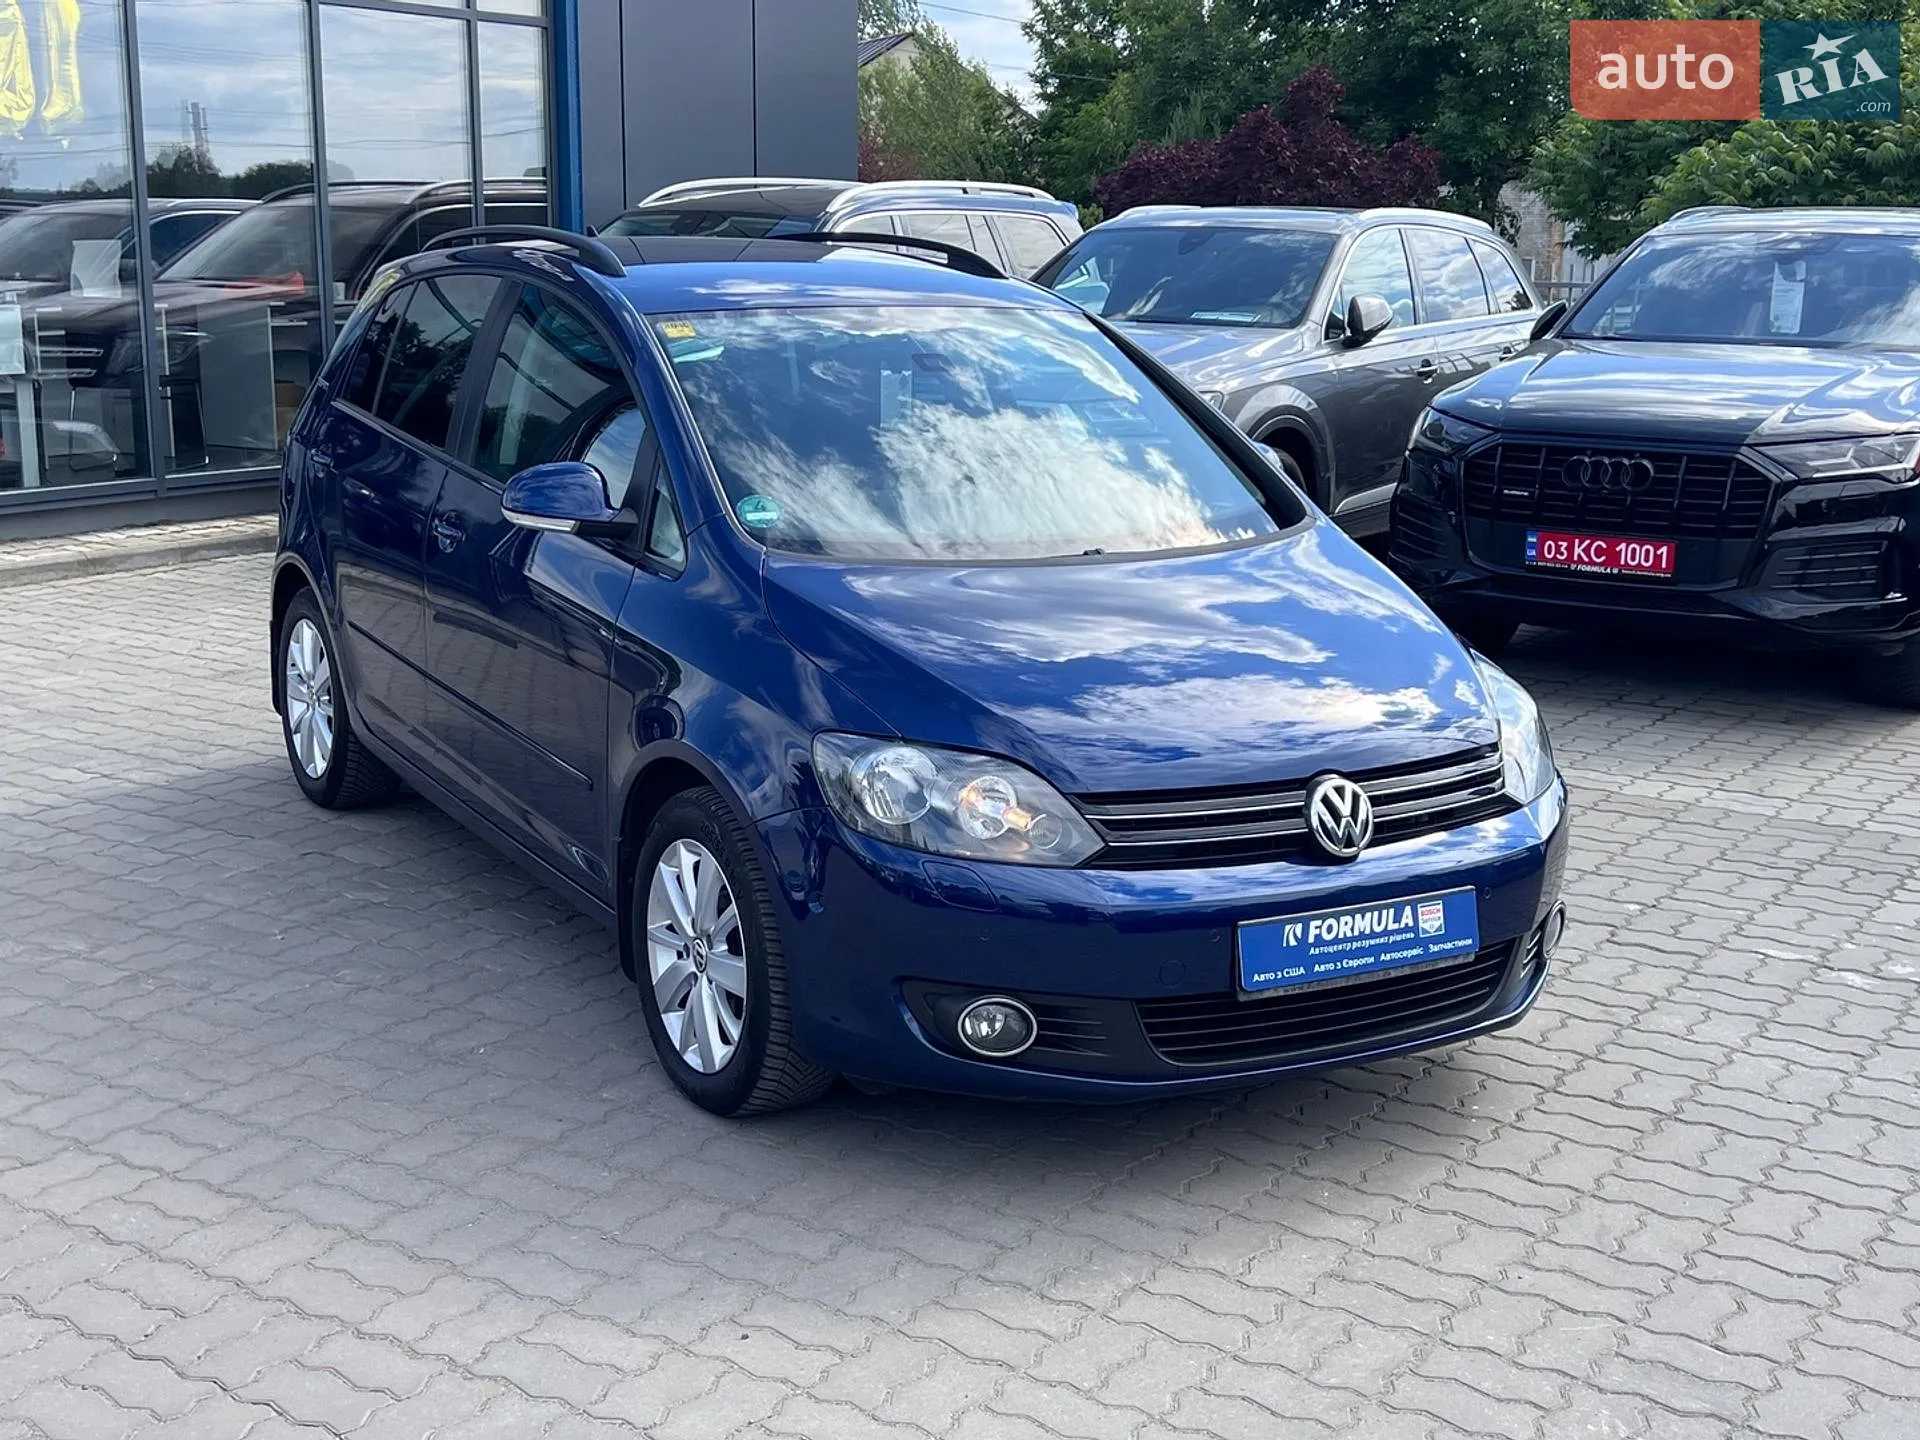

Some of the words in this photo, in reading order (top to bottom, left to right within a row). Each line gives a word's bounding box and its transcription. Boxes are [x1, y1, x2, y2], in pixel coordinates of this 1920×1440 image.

[1543, 540, 1568, 560] 03
[1573, 538, 1607, 563] KC
[1615, 542, 1668, 569] 1001
[1307, 905, 1414, 944] FORMULA
[1253, 972, 1275, 983] Авто
[1283, 967, 1306, 978] США
[1313, 961, 1335, 973] Авто
[1342, 956, 1375, 969] Європи
[1380, 945, 1424, 962] Автосервіс
[1428, 938, 1473, 953] Запчастини
